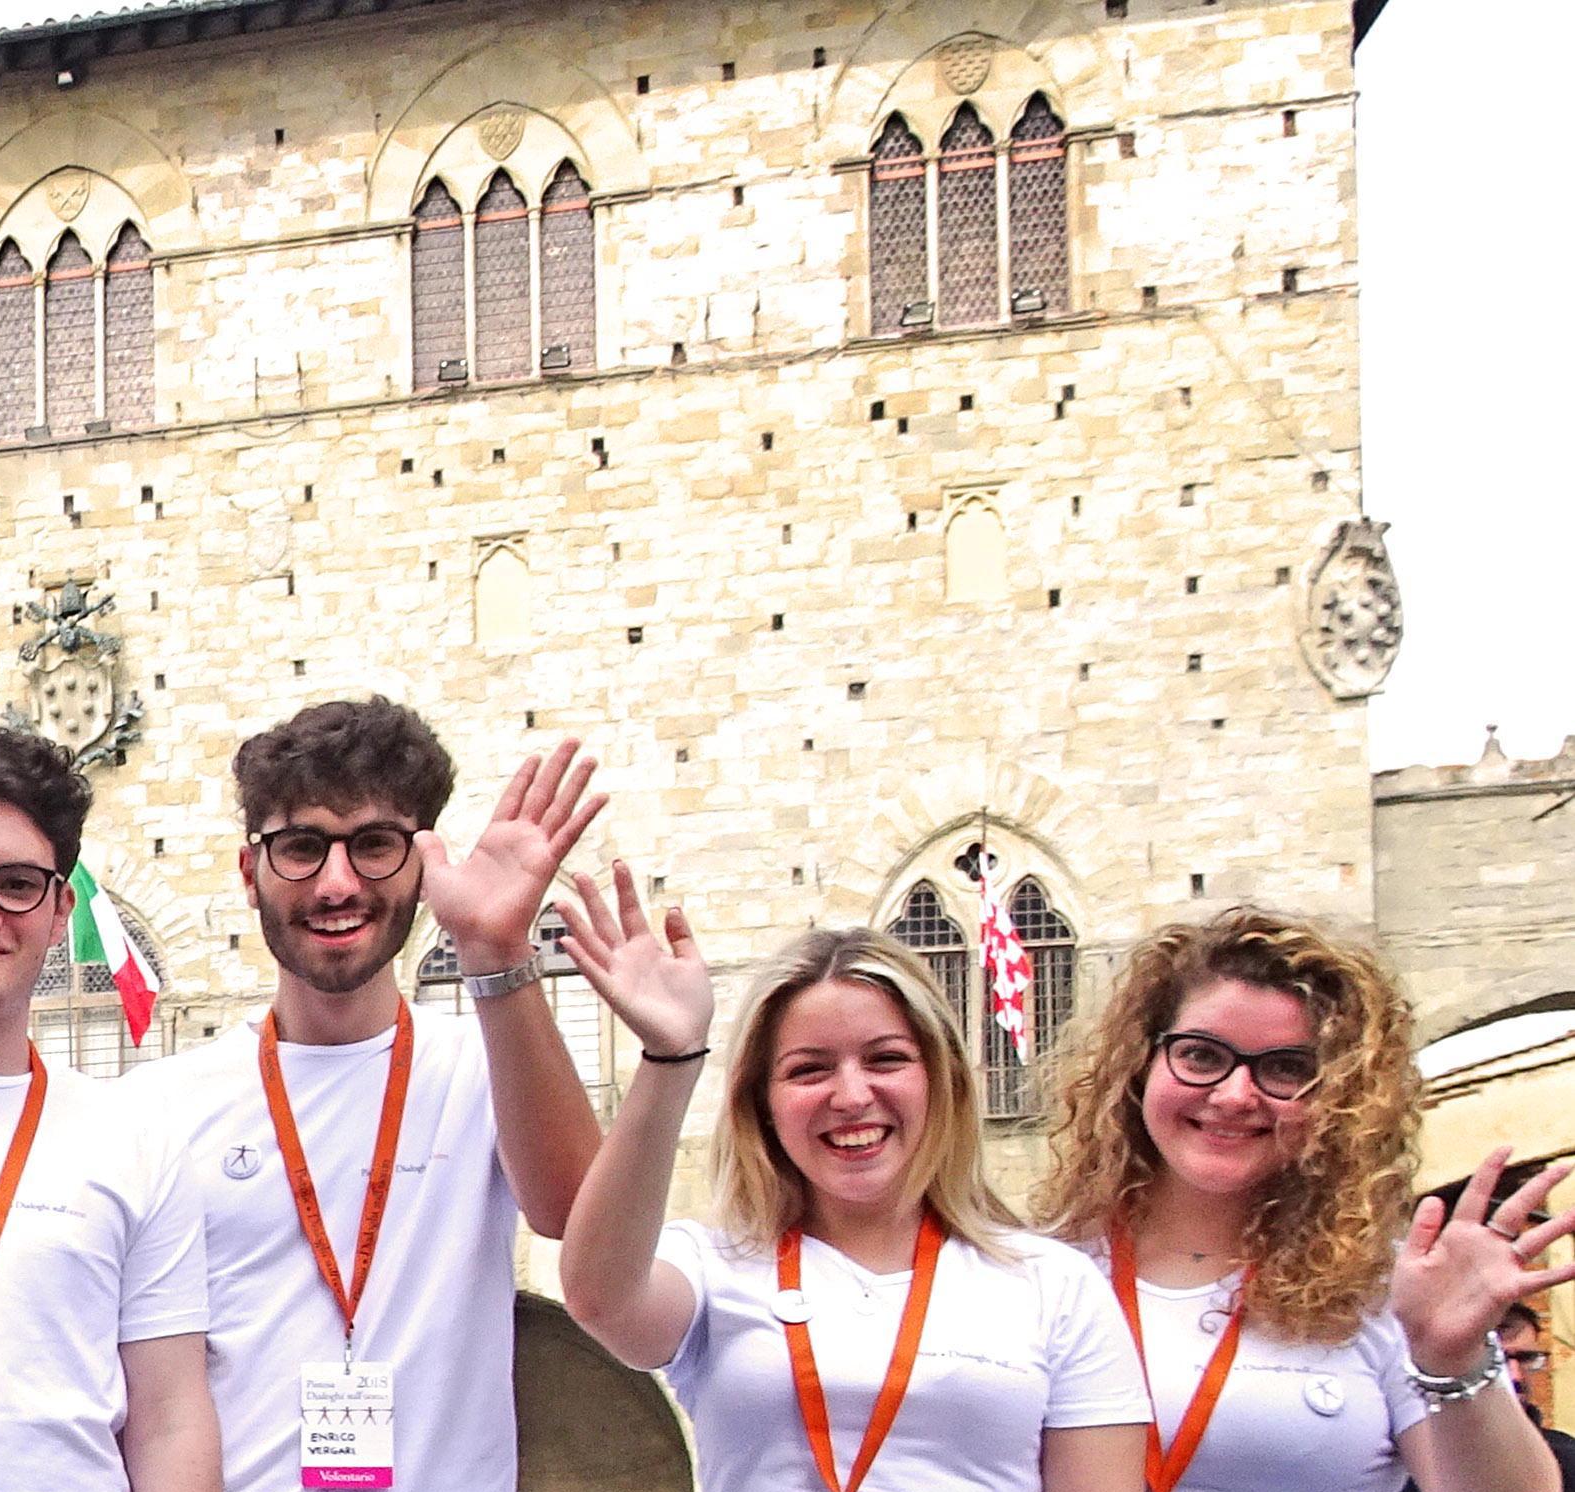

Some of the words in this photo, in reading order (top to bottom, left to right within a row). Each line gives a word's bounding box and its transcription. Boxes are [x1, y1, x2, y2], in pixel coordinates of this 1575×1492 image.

[357, 1376, 388, 1388] 2018
[307, 1391, 344, 1402] Dialoghi
[310, 1432, 356, 1442] ENRICO
[319, 1470, 376, 1482] Volontario
